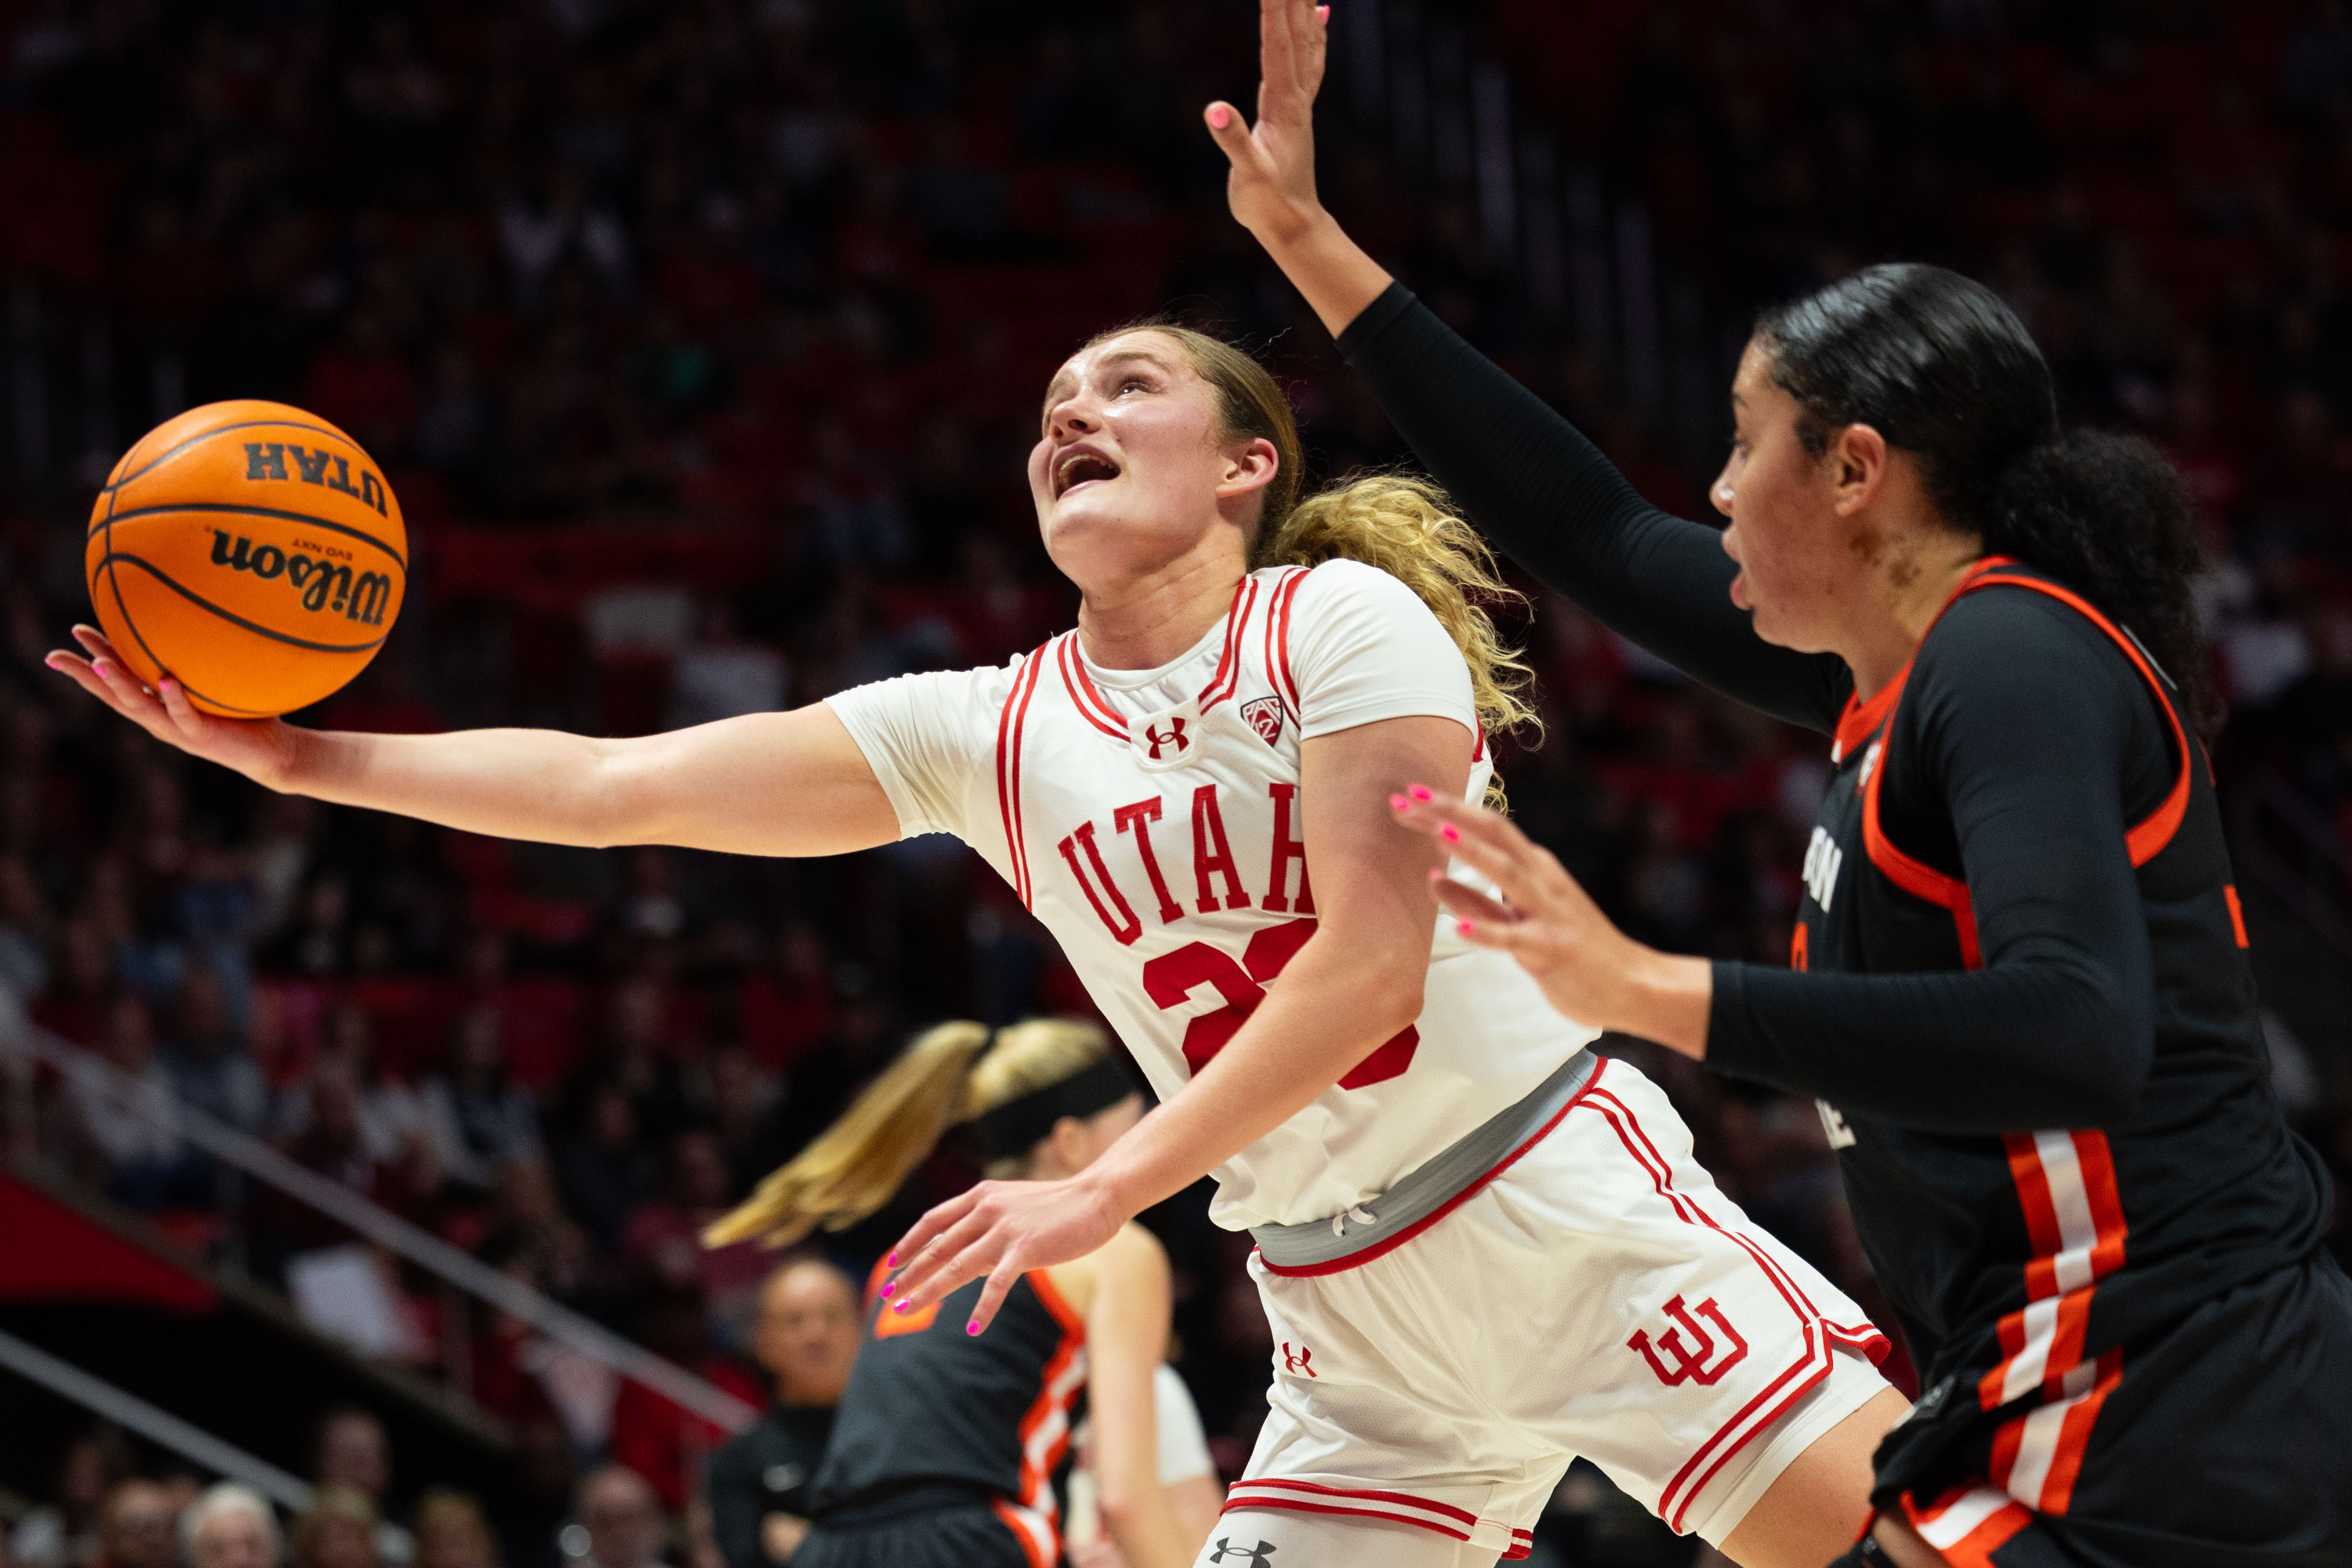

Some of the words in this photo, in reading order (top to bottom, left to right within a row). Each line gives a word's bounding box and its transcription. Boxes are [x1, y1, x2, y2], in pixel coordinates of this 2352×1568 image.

[243, 442, 388, 518] UTAH
[211, 528, 390, 626] Wilson
[292, 538, 323, 553] NXT
[326, 546, 353, 561] EVO
[1057, 783, 1317, 946] UTAH
